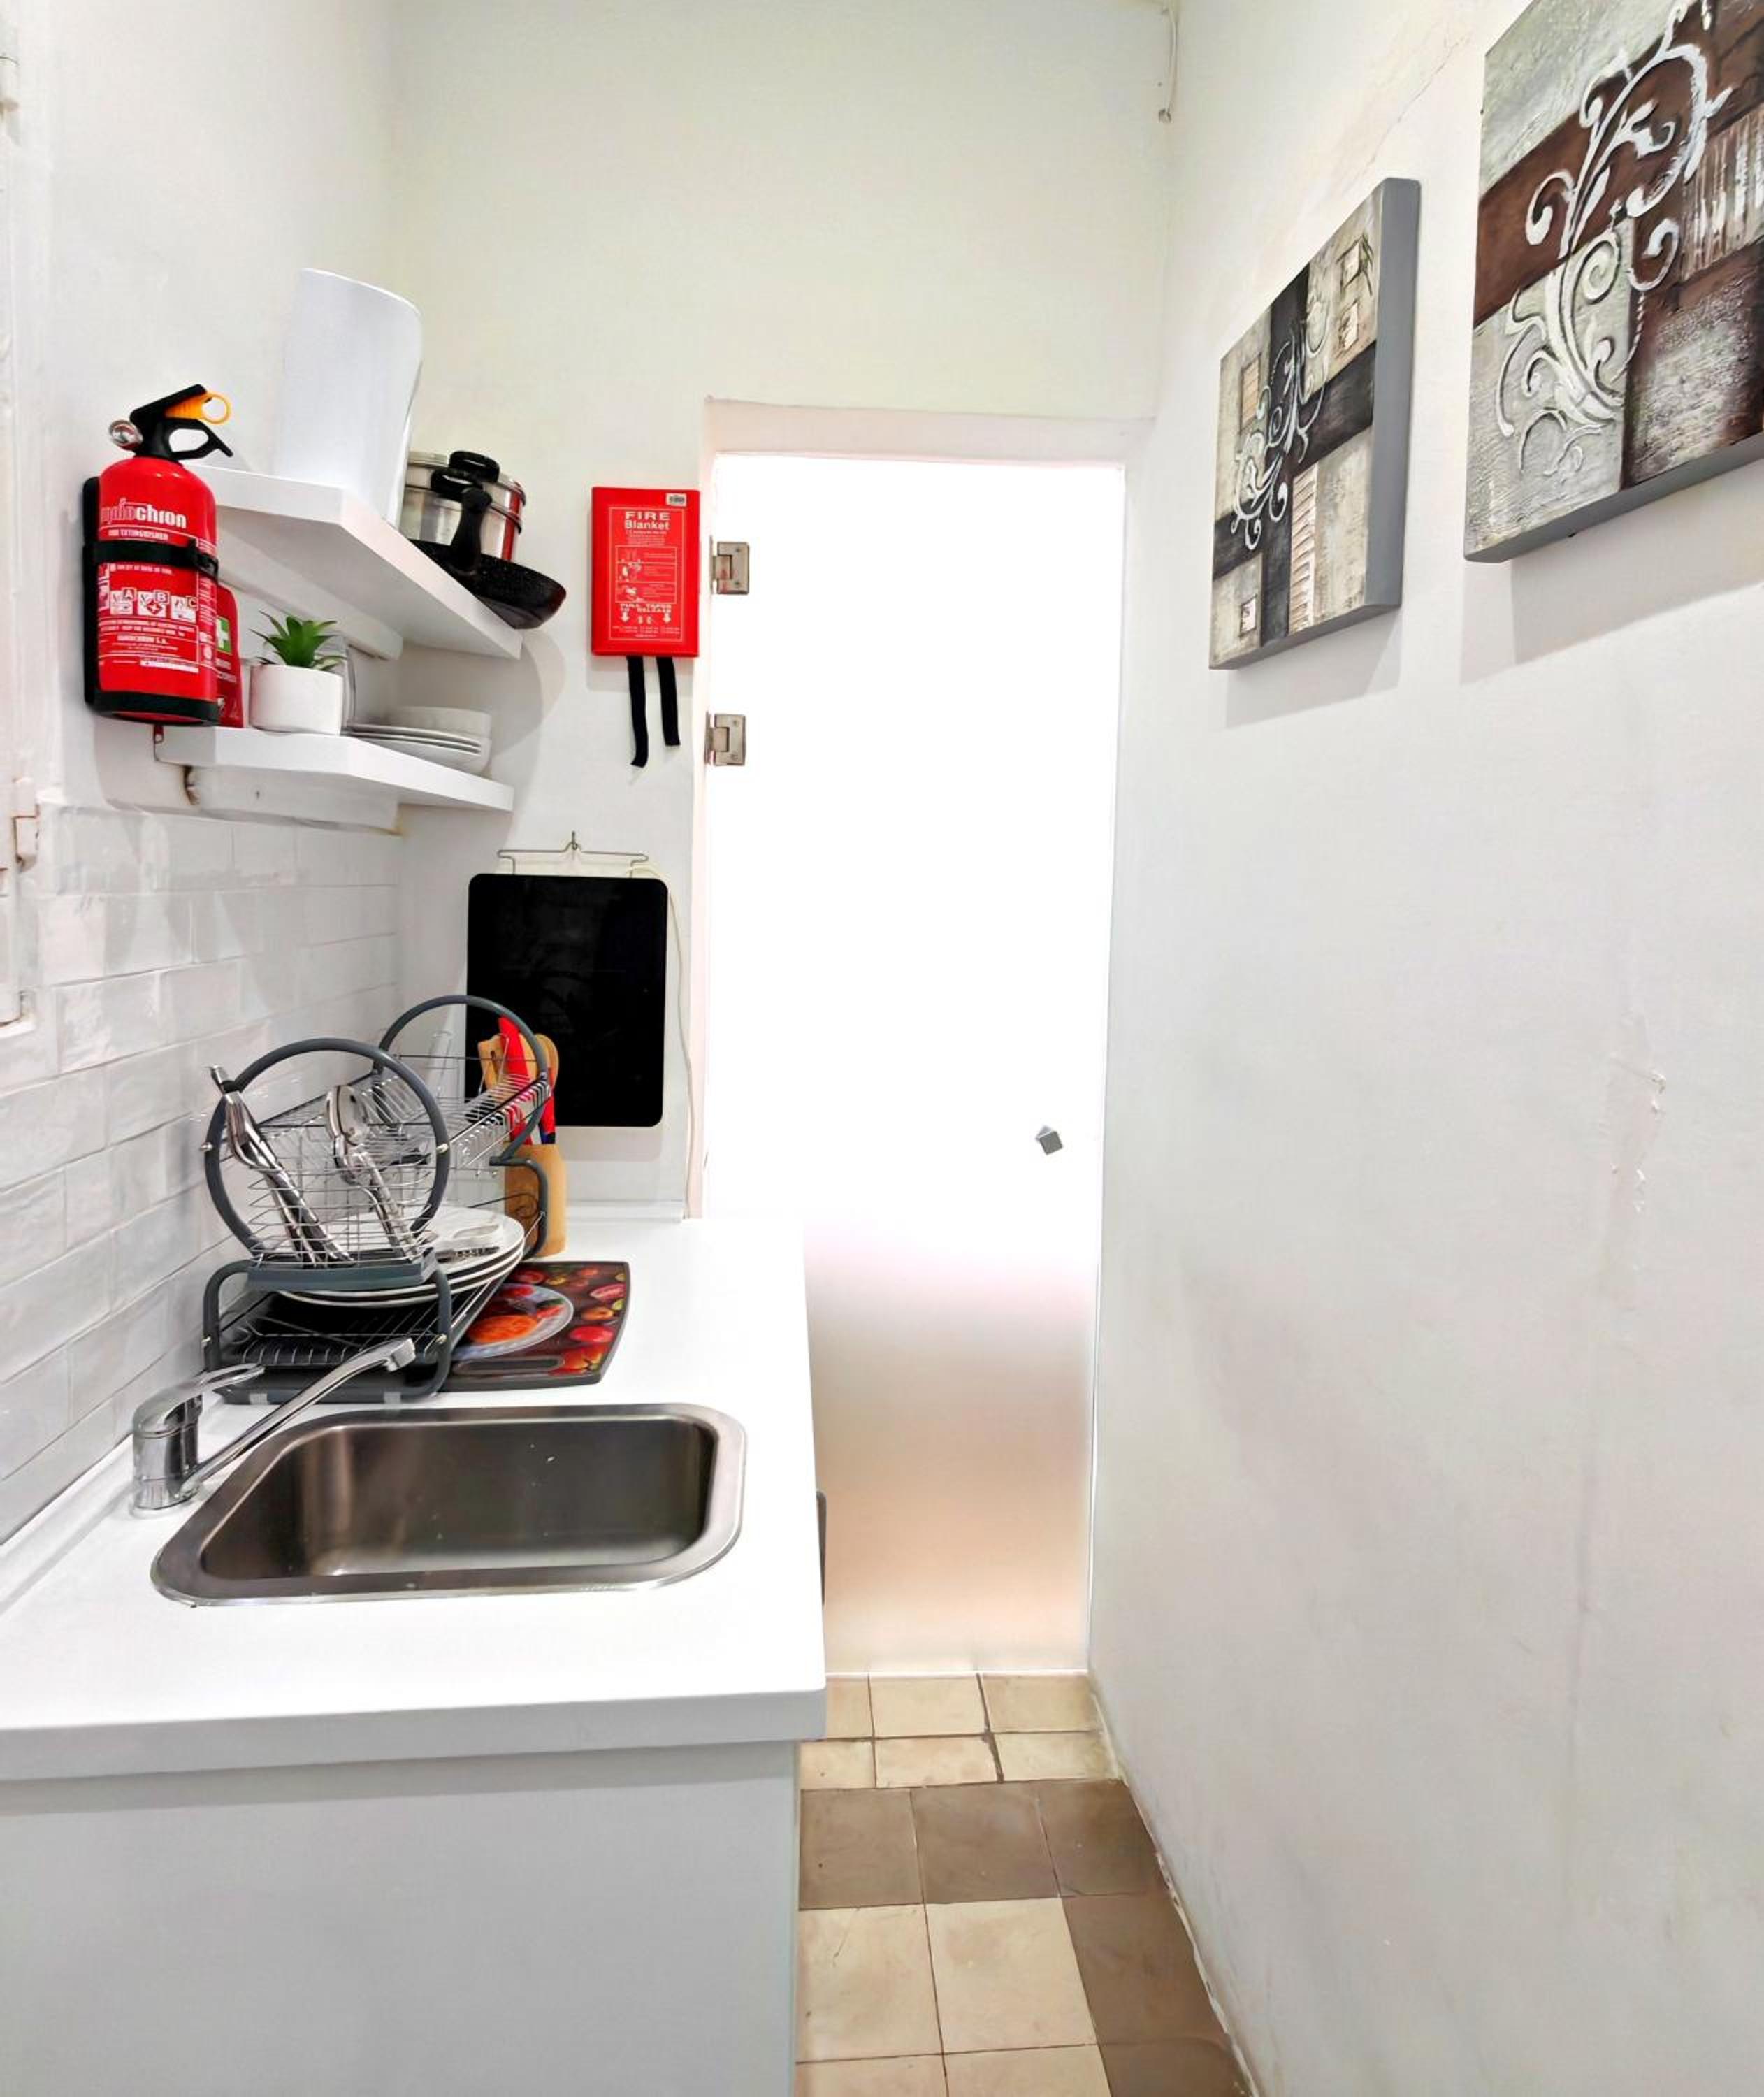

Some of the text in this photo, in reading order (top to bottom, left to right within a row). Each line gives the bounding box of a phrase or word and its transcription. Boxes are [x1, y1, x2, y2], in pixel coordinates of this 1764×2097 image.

[626, 511, 670, 520] FIRE
[625, 519, 670, 530] Blanket
[124, 589, 133, 599] A
[157, 593, 166, 602] B
